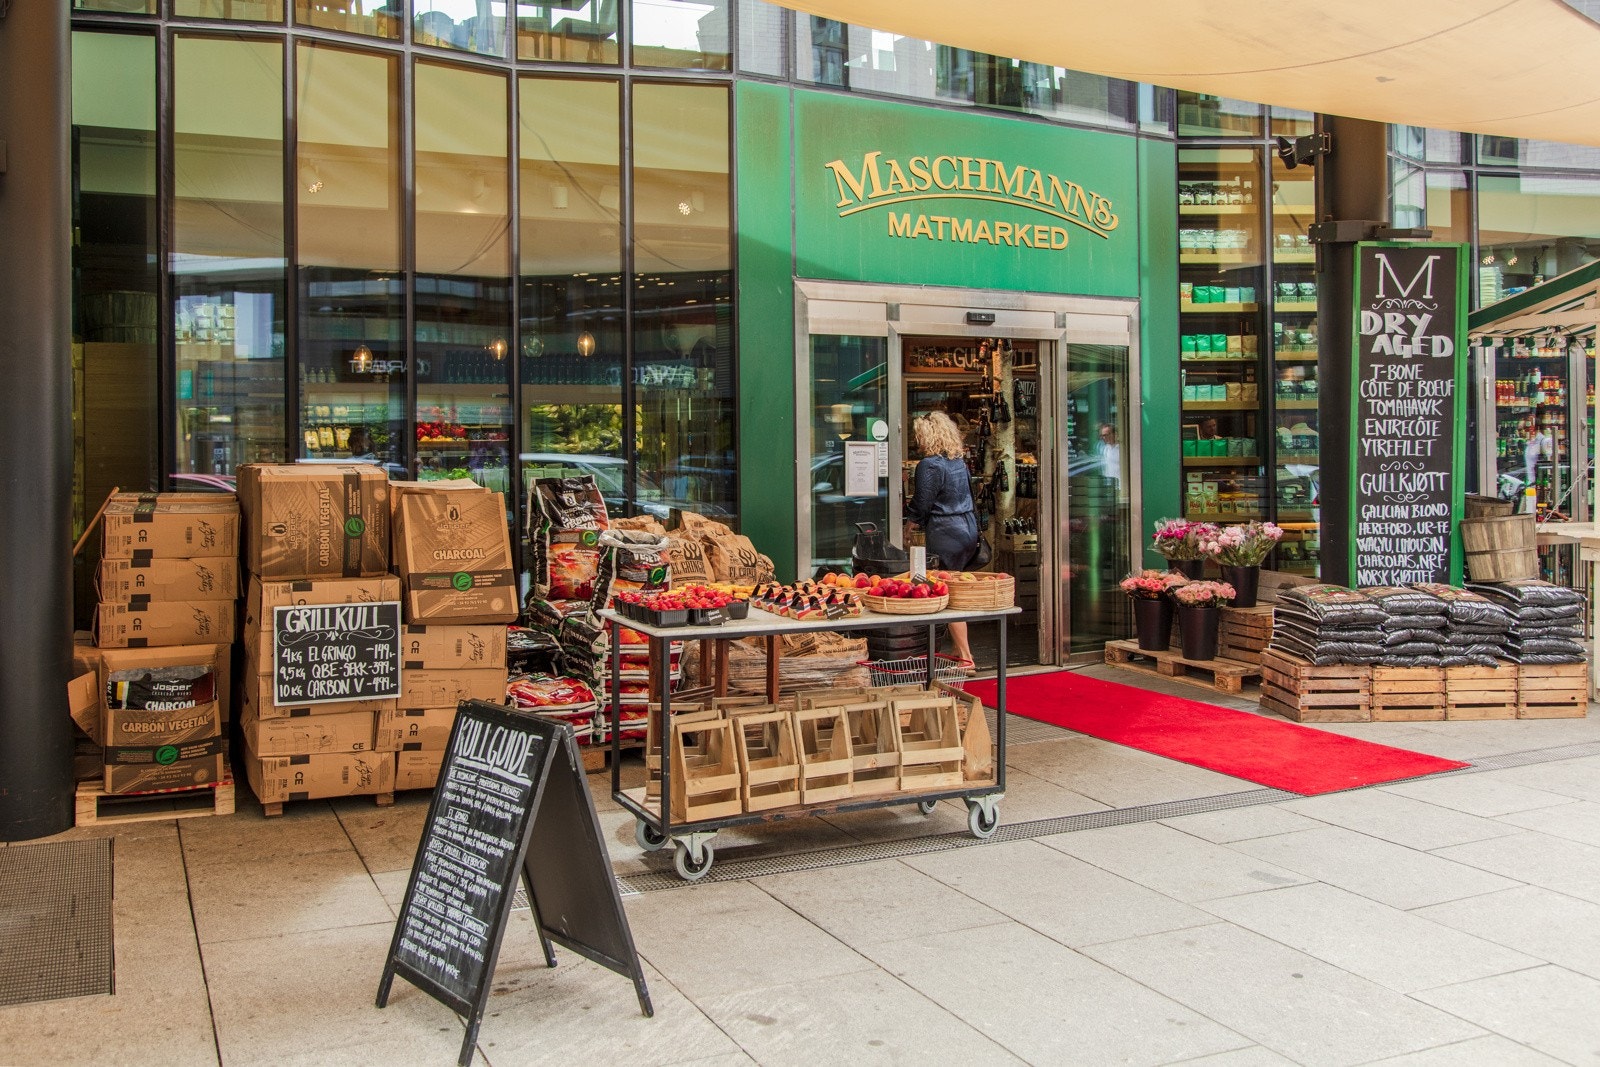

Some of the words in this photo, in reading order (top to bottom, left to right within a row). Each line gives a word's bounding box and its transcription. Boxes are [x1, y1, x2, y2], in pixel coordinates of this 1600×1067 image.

[825, 151, 1119, 231] MASCHMANNS
[888, 212, 1069, 250] MATMARKED
[1374, 253, 1441, 299] M
[1359, 310, 1433, 337] DRY
[1371, 334, 1454, 358] AGED
[1370, 364, 1424, 381] T-BONE
[1398, 381, 1414, 398] DE
[1367, 399, 1442, 417] TOMAHAWK
[1365, 416, 1442, 438] ENTRECÔTE
[1361, 438, 1437, 457] YTREFILET
[1360, 472, 1450, 496] GULLKJØTT
[319, 488, 330, 528] VEGETAL
[1362, 504, 1409, 521] GALICIAN
[139, 529, 147, 543] CE
[433, 548, 486, 560] CHARCOAL
[136, 574, 145, 588] CE
[1357, 569, 1389, 586] NORSK
[133, 617, 142, 631] CE
[285, 606, 390, 633] GRILLKULL
[321, 645, 356, 662] GRINGO
[411, 640, 420, 654] CE
[153, 683, 193, 692] Josper
[307, 678, 350, 698] CARBON
[354, 678, 365, 693] V
[122, 719, 165, 733] CARBÓN
[169, 716, 209, 731] VEGETAL
[410, 723, 418, 737] CE
[295, 771, 303, 785] CE
